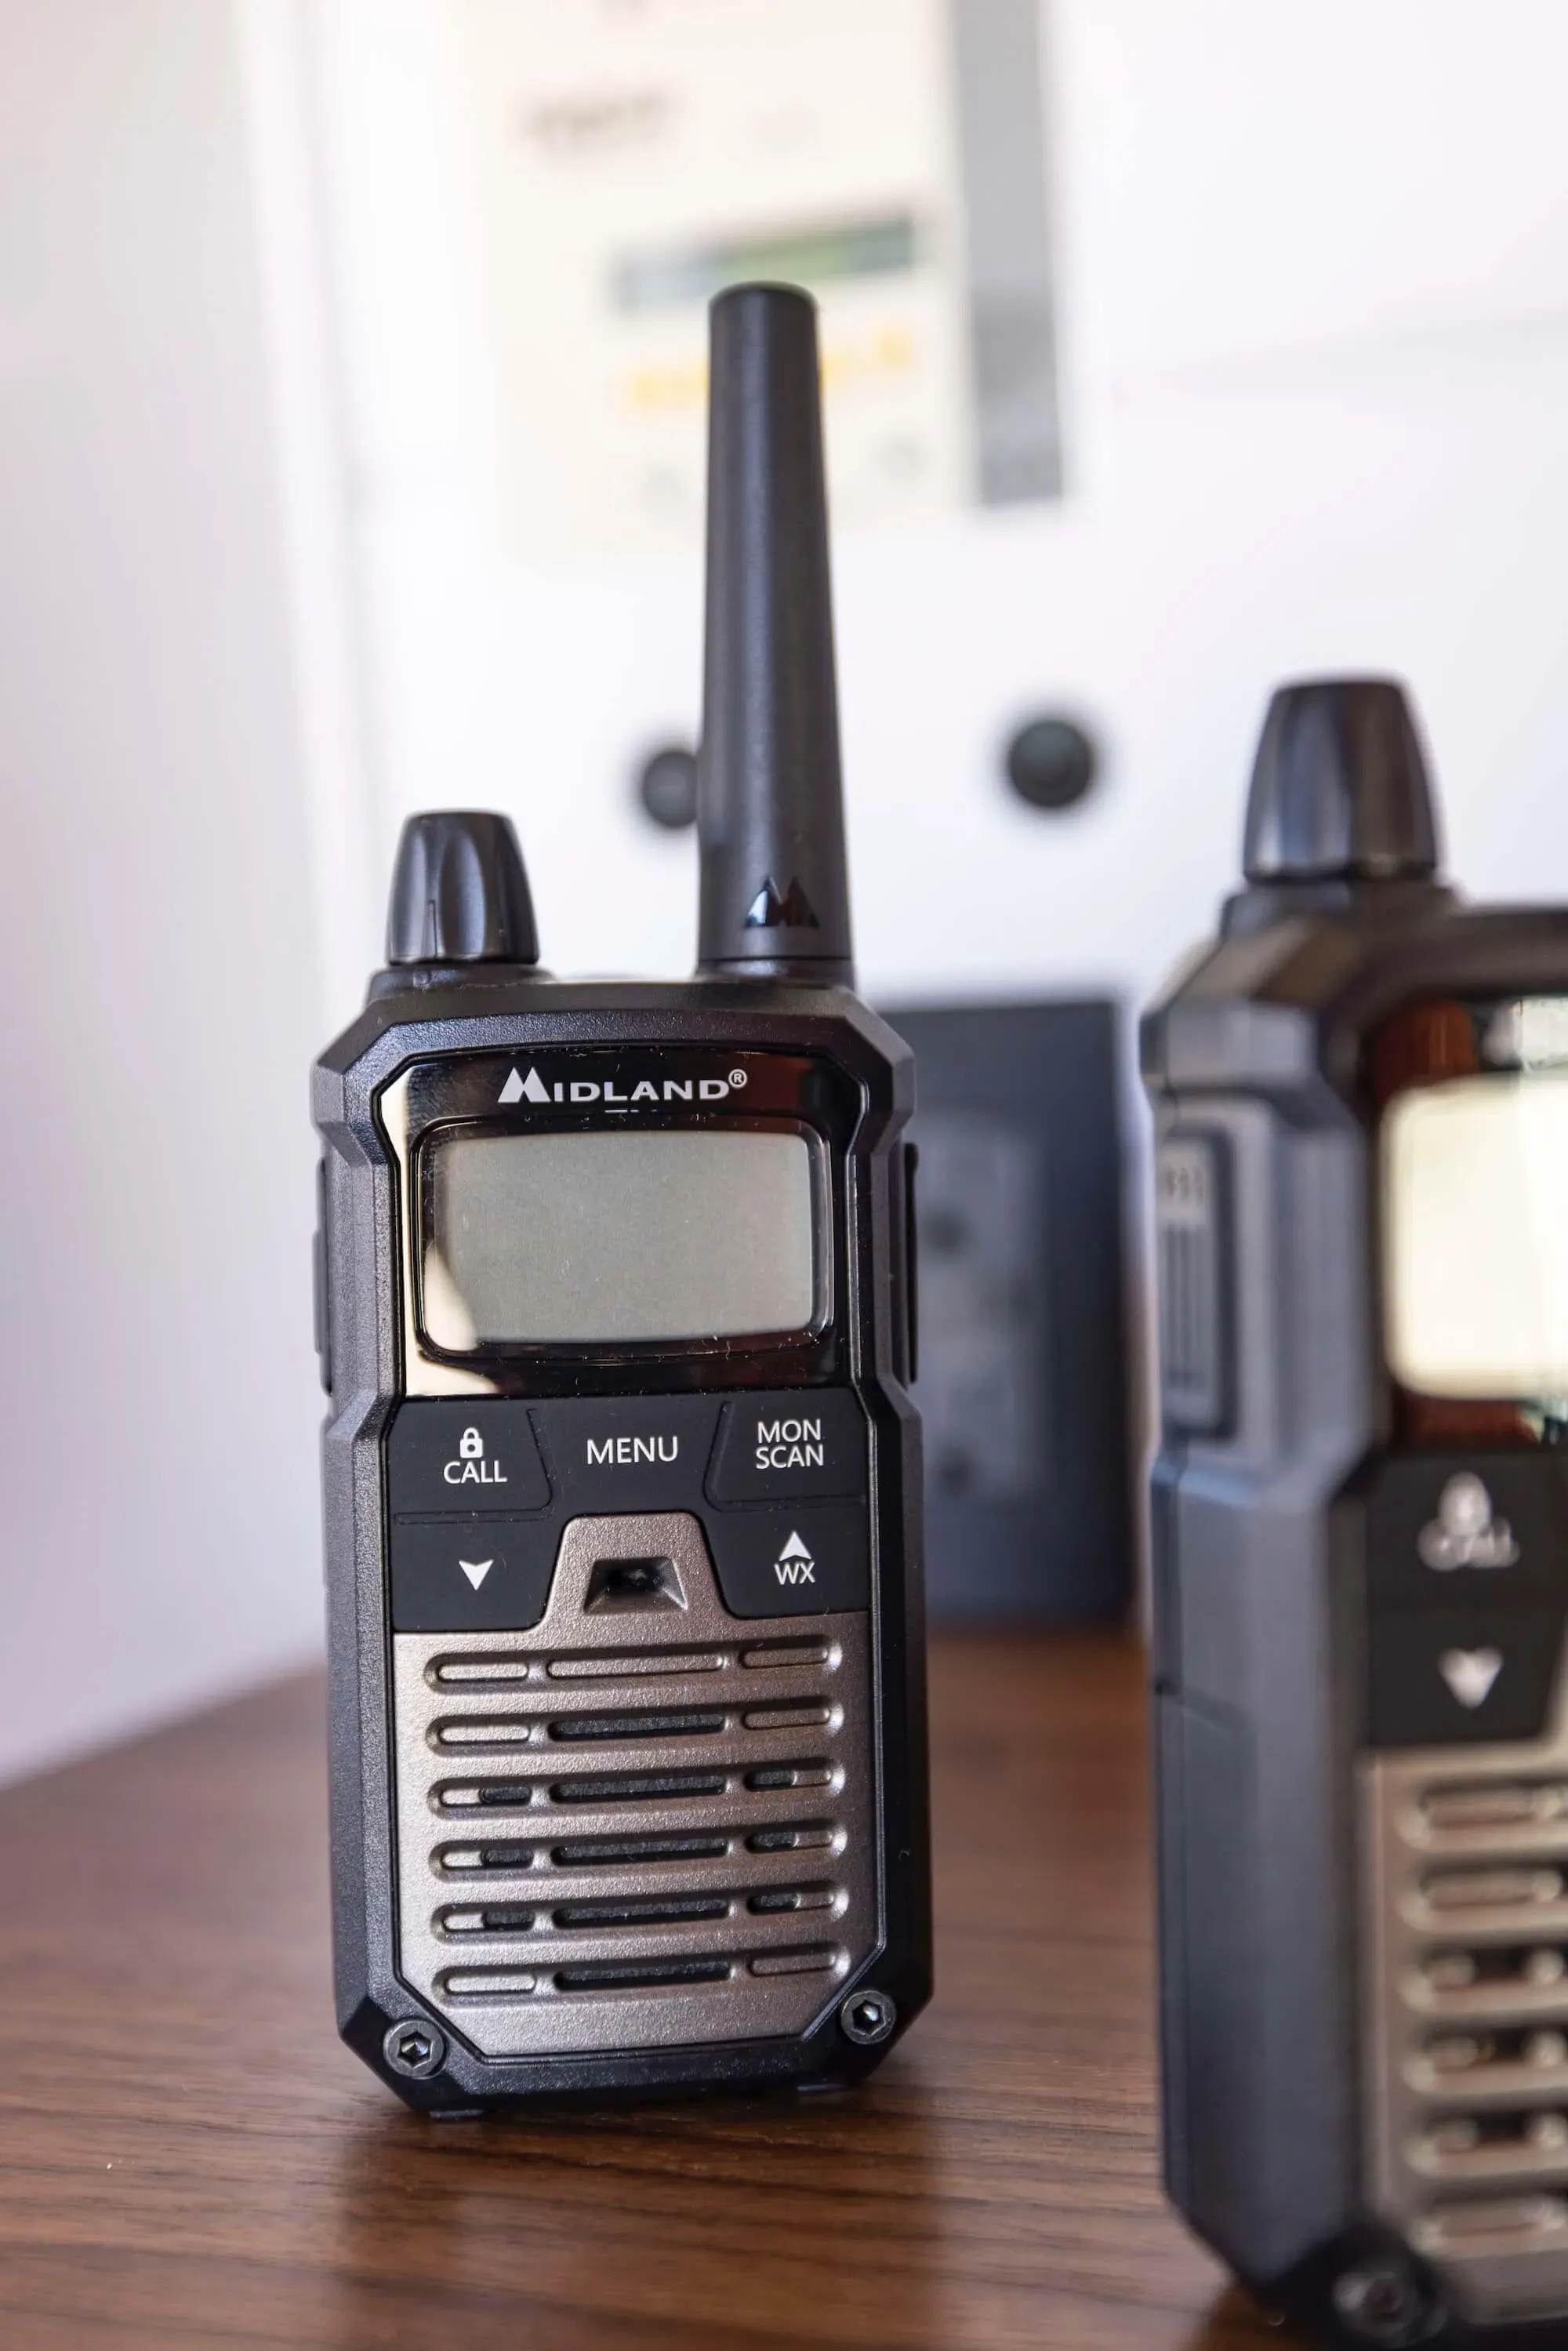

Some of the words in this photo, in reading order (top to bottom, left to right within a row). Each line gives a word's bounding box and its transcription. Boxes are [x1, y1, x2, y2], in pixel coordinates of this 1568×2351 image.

[757, 1419, 821, 1442] MON
[586, 1435, 679, 1465] MENU
[755, 1444, 824, 1470] SCAN
[443, 1459, 508, 1484] CALL
[774, 1561, 816, 1585] WX
